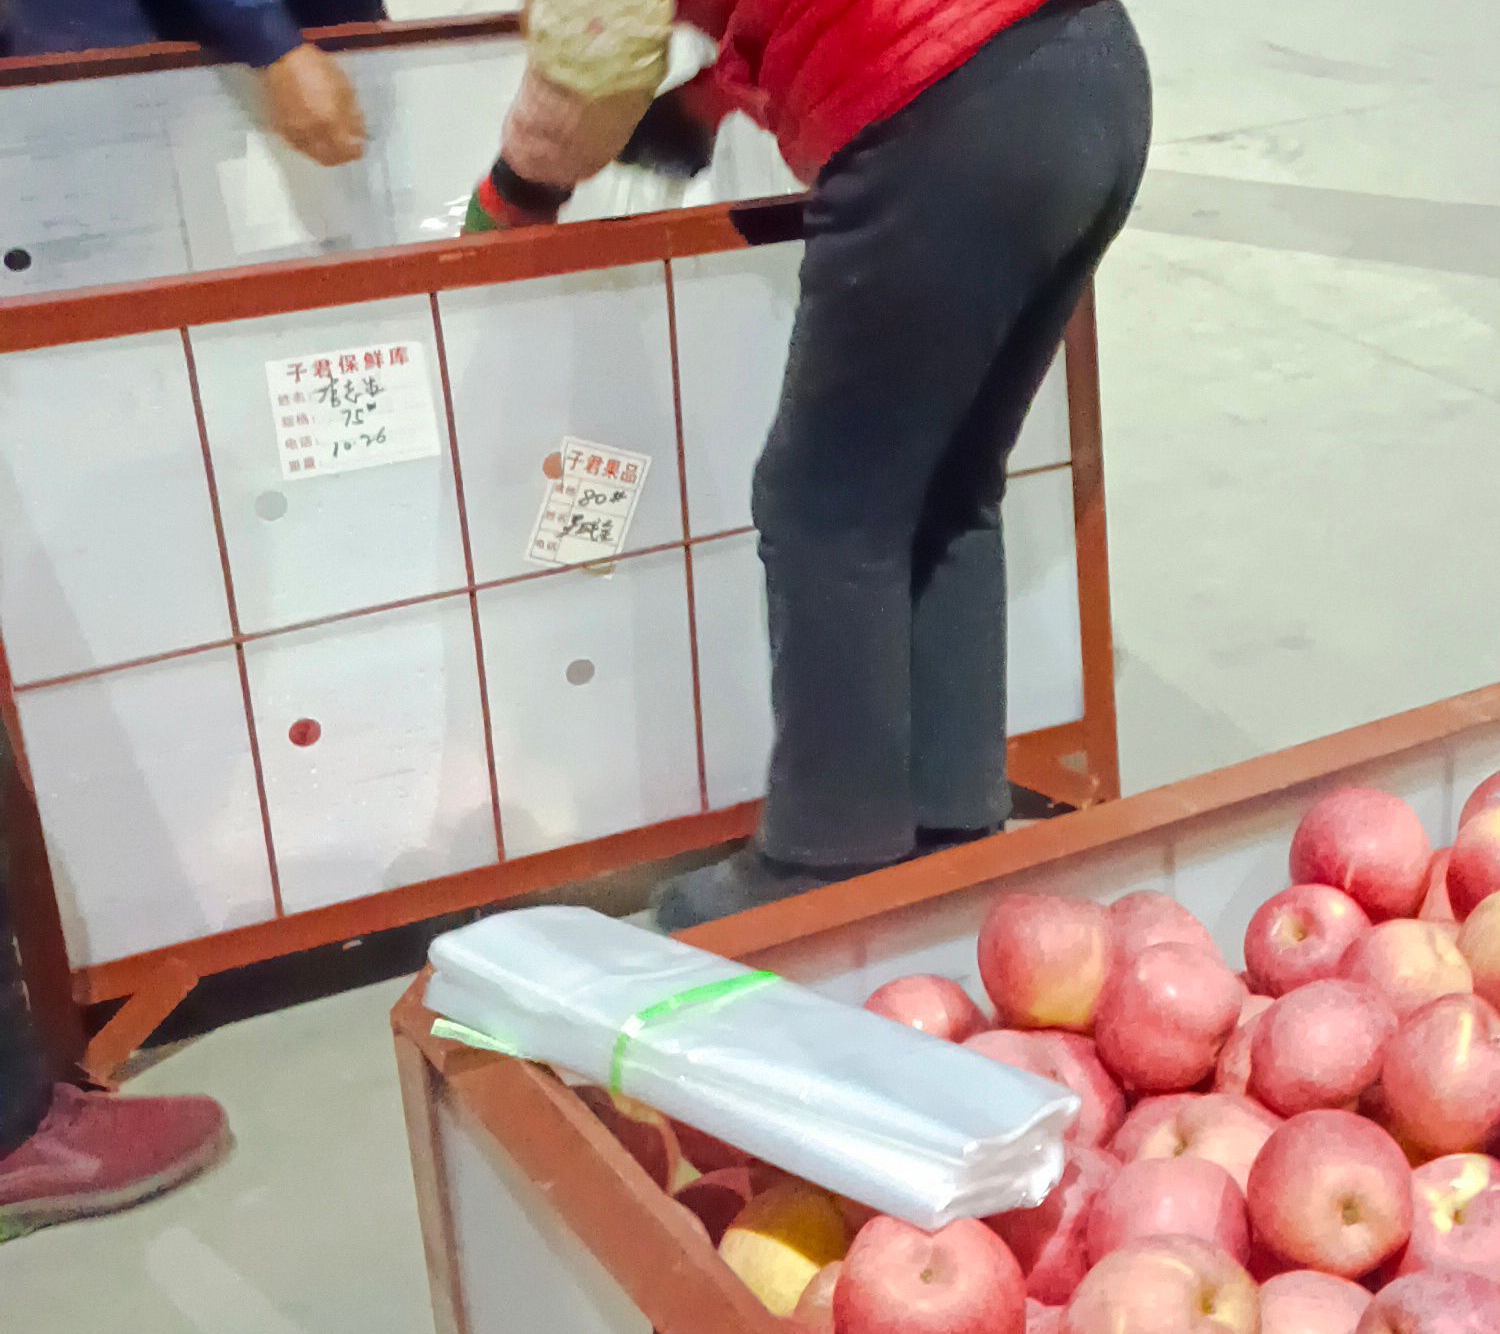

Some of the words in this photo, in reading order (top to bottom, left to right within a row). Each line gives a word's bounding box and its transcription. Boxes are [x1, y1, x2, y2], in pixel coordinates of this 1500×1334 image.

[286, 346, 409, 383] 子君保鲜库
[566, 449, 640, 485] 子君果品
